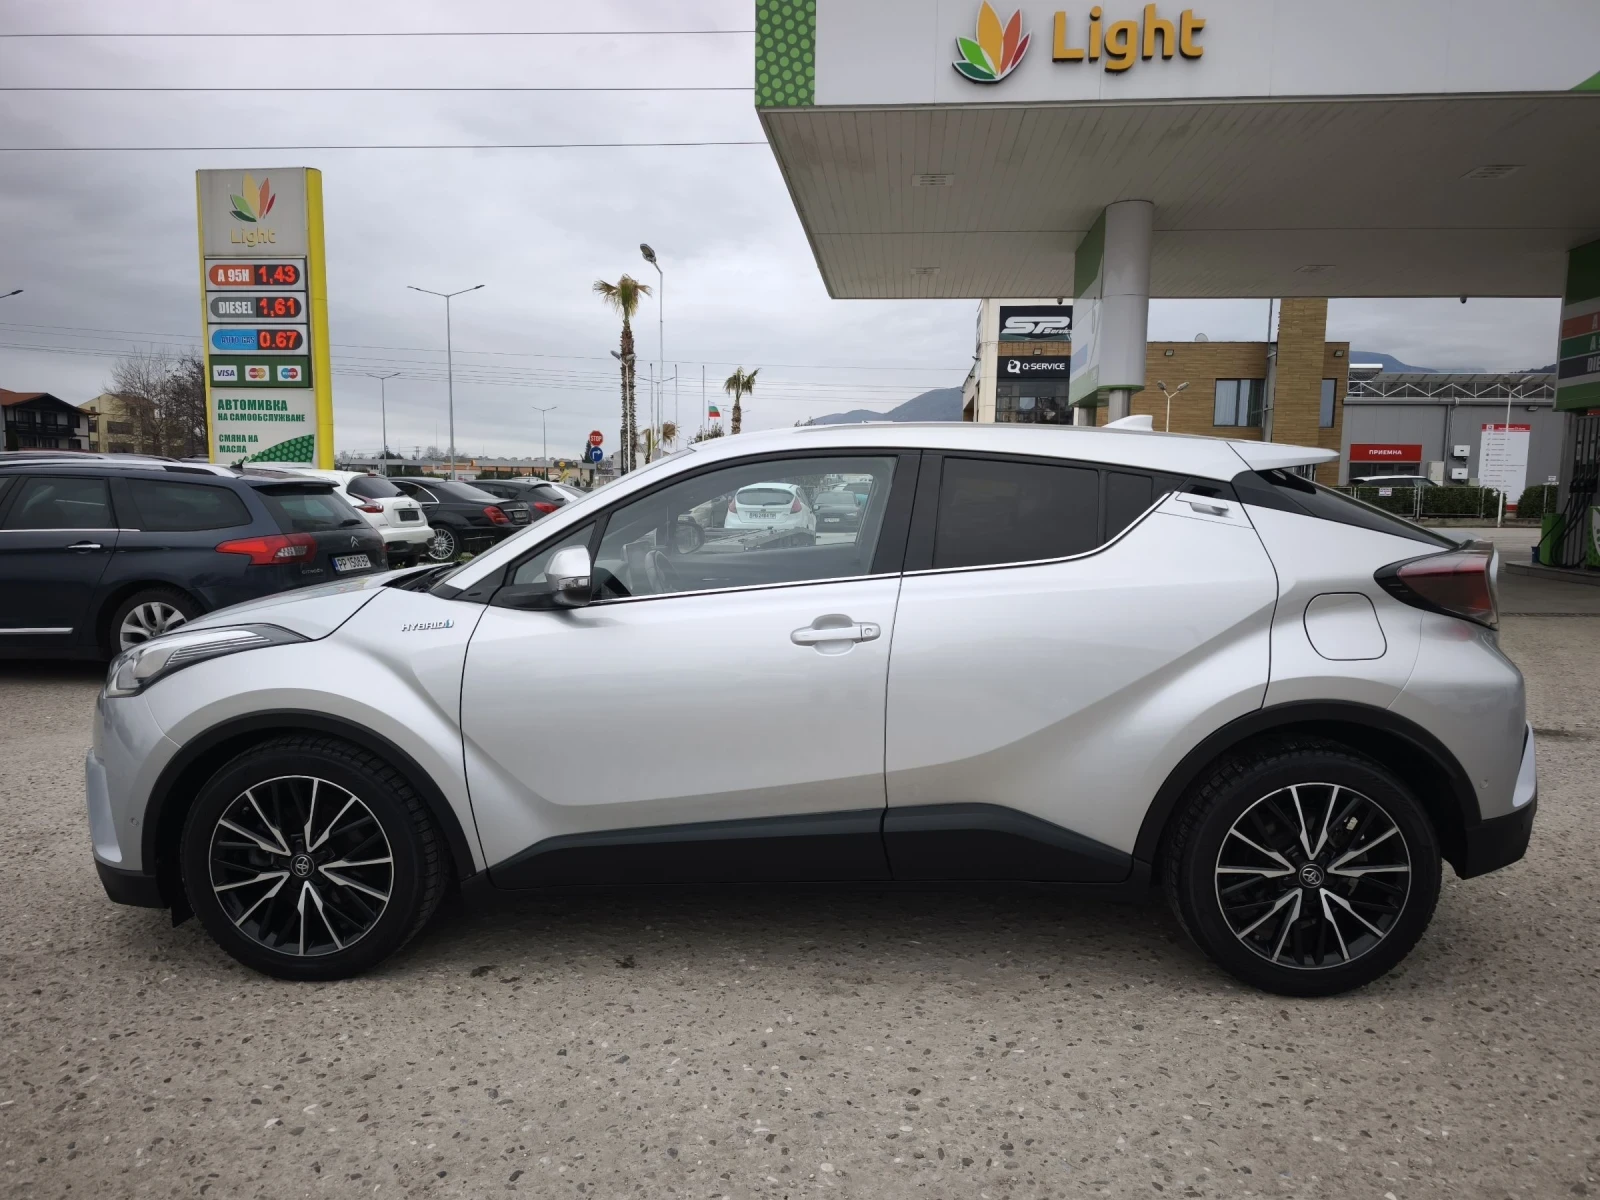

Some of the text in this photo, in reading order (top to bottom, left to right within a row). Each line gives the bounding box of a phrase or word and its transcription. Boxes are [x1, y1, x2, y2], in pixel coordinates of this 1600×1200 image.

[1052, 3, 1207, 73] Light
[230, 227, 277, 247] Light
[218, 301, 253, 314] DIESEL
[1000, 316, 1071, 334] SP
[221, 331, 298, 349] AUTO GAS 0.67
[1587, 355, 1600, 373] DIE
[216, 369, 236, 377] VISA
[217, 398, 288, 411] АВТОМИВКА
[217, 413, 306, 422] НА САМООБСЛУЖВАНЕ
[218, 434, 259, 443] СМЯНА НА
[219, 445, 248, 453] МАСЛА
[401, 621, 446, 632] HYBRID
